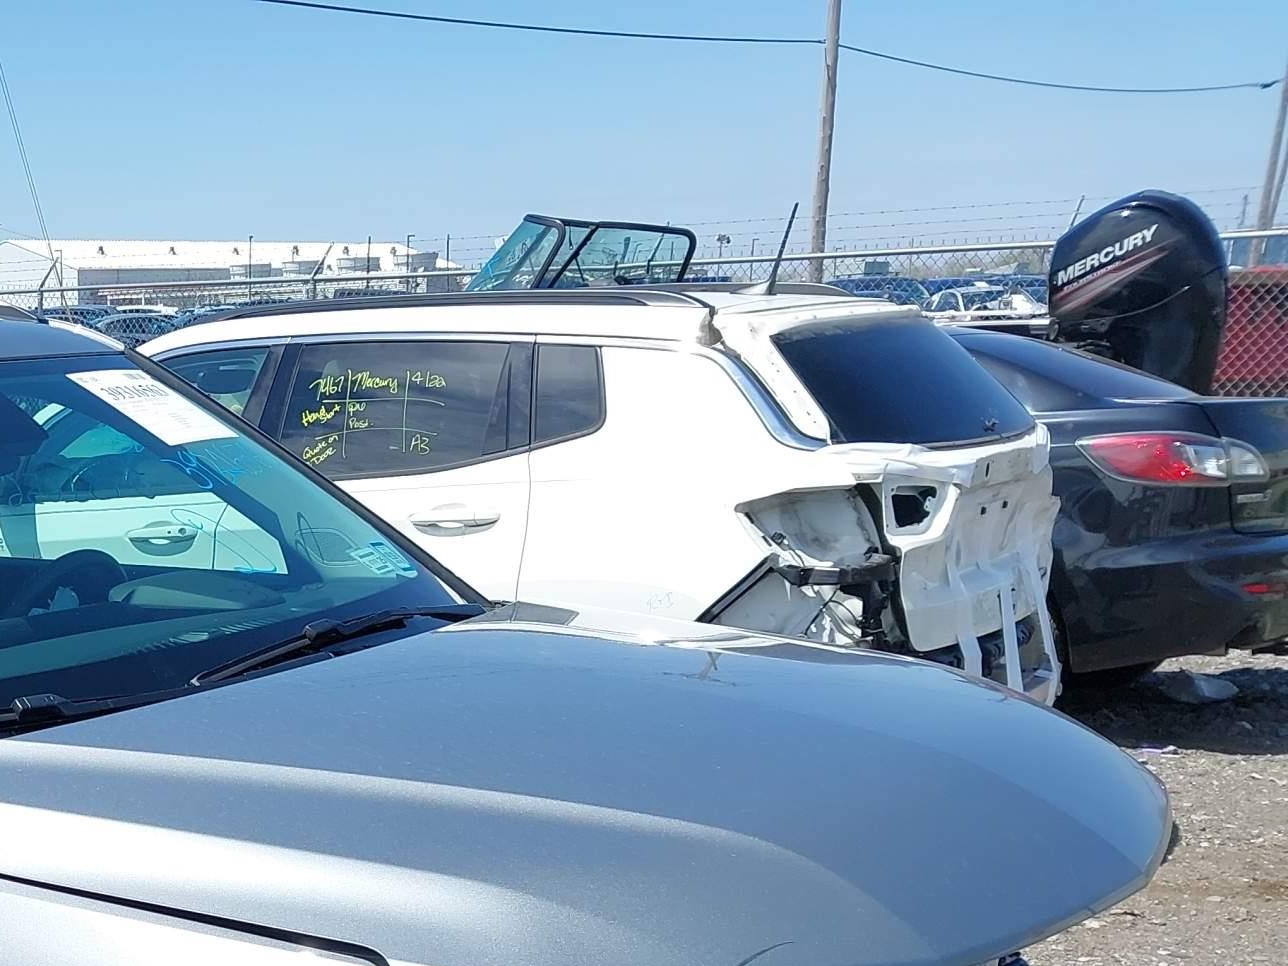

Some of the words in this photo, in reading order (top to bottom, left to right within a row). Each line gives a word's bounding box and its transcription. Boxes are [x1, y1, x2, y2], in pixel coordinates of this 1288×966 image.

[1056, 223, 1159, 287] MERCURY
[351, 371, 399, 394] Mercury
[410, 433, 430, 455] A3
